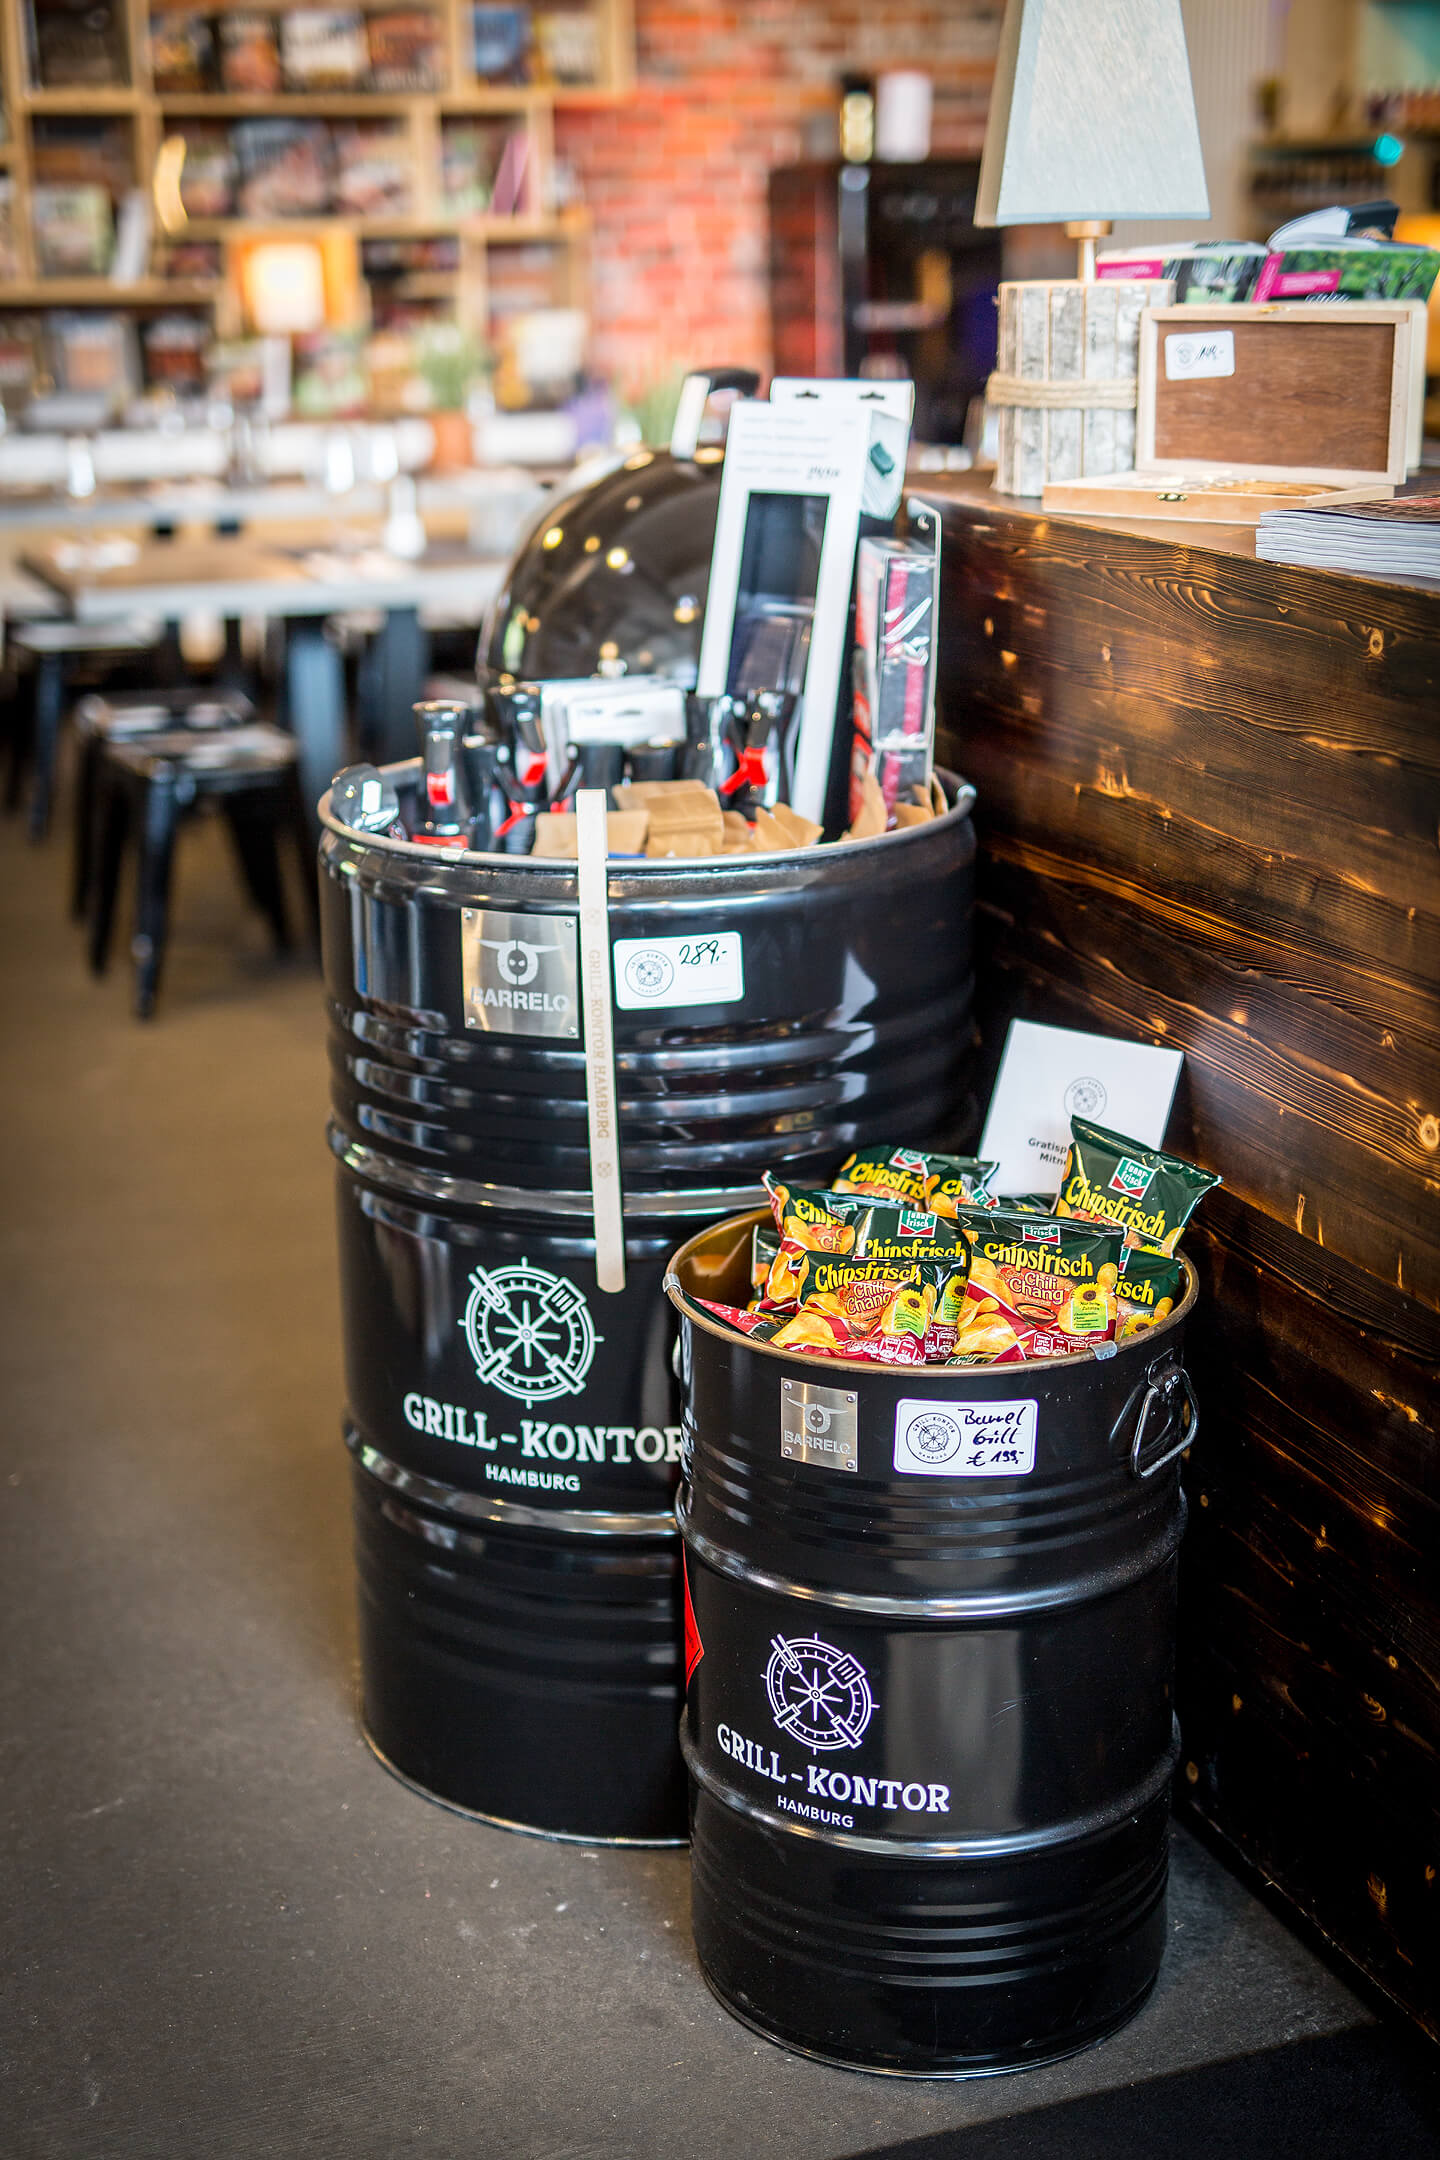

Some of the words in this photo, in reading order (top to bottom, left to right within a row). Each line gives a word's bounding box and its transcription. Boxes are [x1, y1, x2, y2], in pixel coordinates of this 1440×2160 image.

[588, 950, 606, 1059] GRILL-KONTOR
[593, 1065, 610, 1140] HAMBURG
[1040, 1152, 1066, 1166] Mitn
[1065, 1175, 1167, 1238] Chipsfrisch
[983, 1241, 1094, 1277] Chipsfrisch
[815, 1260, 922, 1293] Chipsfrisch
[853, 1280, 887, 1299] Chili
[1009, 1277, 1065, 1305] Chang
[1024, 1271, 1058, 1290] Chili
[846, 1289, 893, 1315] Chang
[965, 1451, 987, 1467] €
[485, 1463, 581, 1492] HAMBURG
[716, 1723, 951, 1813] GRILL-KONTOR
[777, 1794, 855, 1828] HAMBURG
